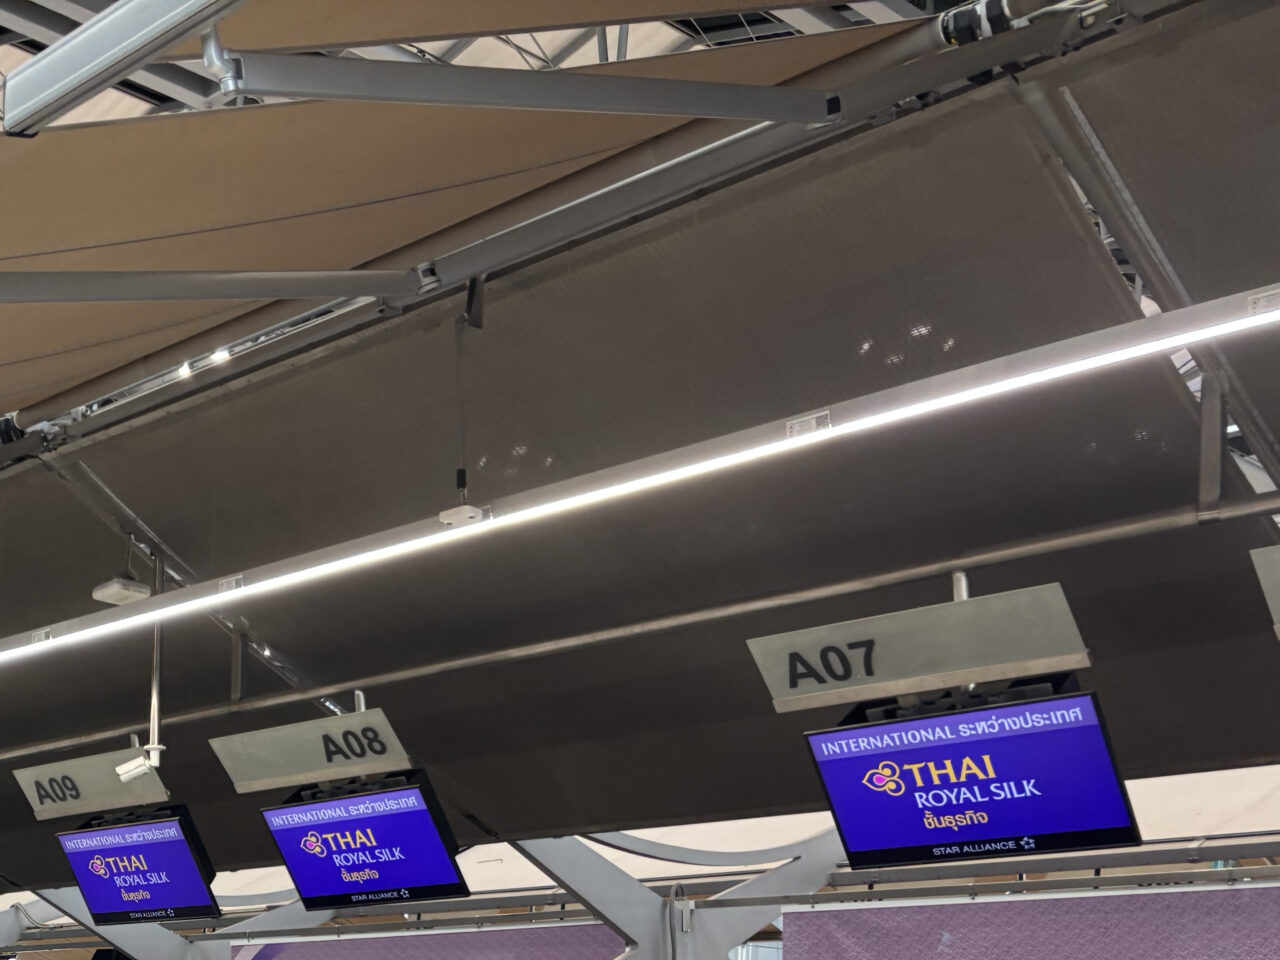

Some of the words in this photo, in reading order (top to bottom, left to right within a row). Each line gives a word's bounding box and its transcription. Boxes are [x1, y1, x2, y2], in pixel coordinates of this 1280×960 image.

[788, 639, 877, 689] A07
[821, 726, 956, 756] INTERNATIONAL
[958, 705, 1084, 739] ระหว่างประเทศ
[321, 727, 388, 763] A08
[904, 754, 998, 787] THAI
[34, 775, 81, 805] A09
[914, 784, 989, 809] ROYAL
[990, 778, 1042, 801] SILK
[271, 806, 349, 827] INTERNATIONAL
[349, 795, 418, 818] ระหว่างประเทศ
[923, 809, 989, 832] ชั้นธุรกิจ
[65, 834, 126, 850] INTERNATIONAL
[322, 829, 377, 851] THAI
[932, 846, 961, 856] STAR
[963, 841, 1018, 854] ALLIANCE
[105, 854, 149, 873] THAI
[332, 850, 377, 867] ROYAL
[376, 847, 406, 862] SILK
[114, 873, 148, 888] ROYAL
[147, 872, 170, 884] SILK
